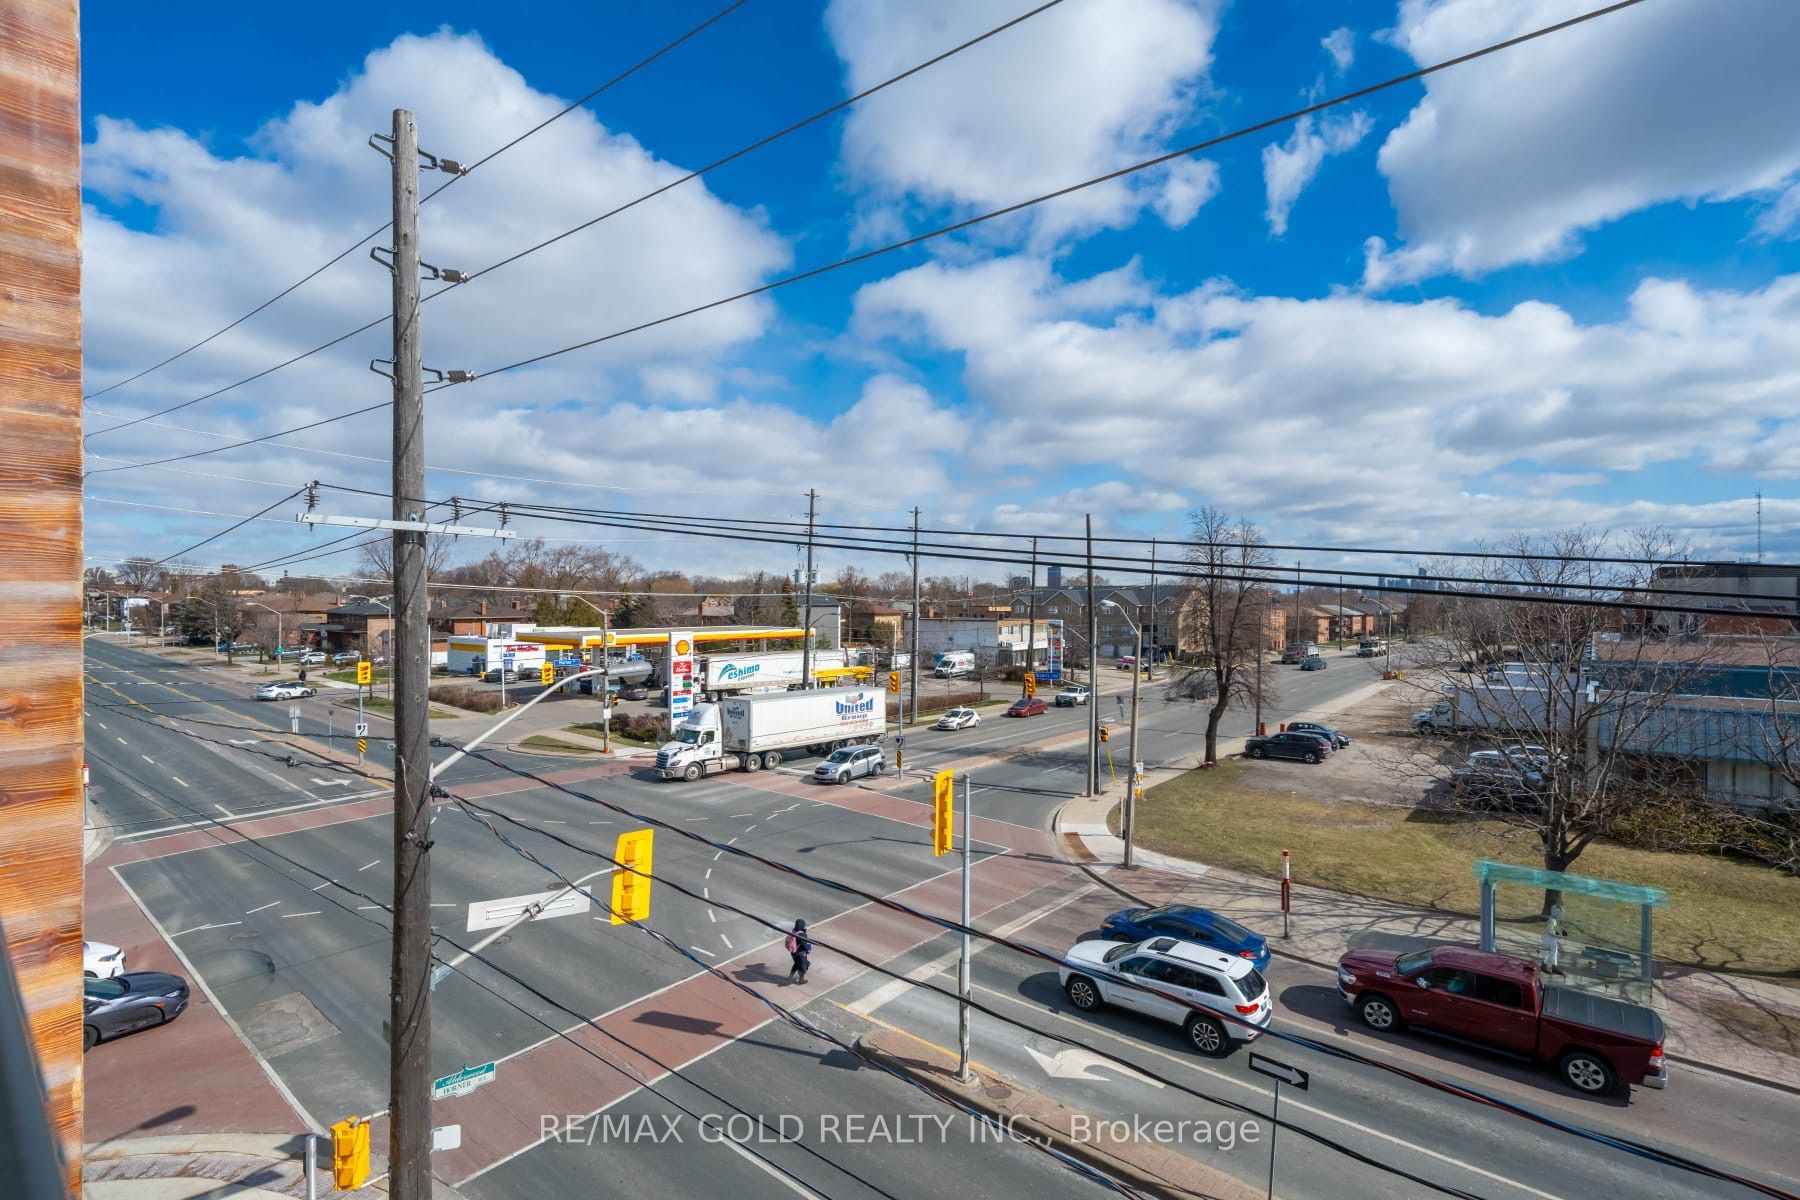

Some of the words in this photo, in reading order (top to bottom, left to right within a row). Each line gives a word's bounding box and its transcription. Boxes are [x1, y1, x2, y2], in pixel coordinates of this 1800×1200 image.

[727, 663, 760, 680] eshimo
[835, 696, 874, 715] United
[841, 713, 868, 721] Group
[443, 1080, 471, 1094] HORNER
